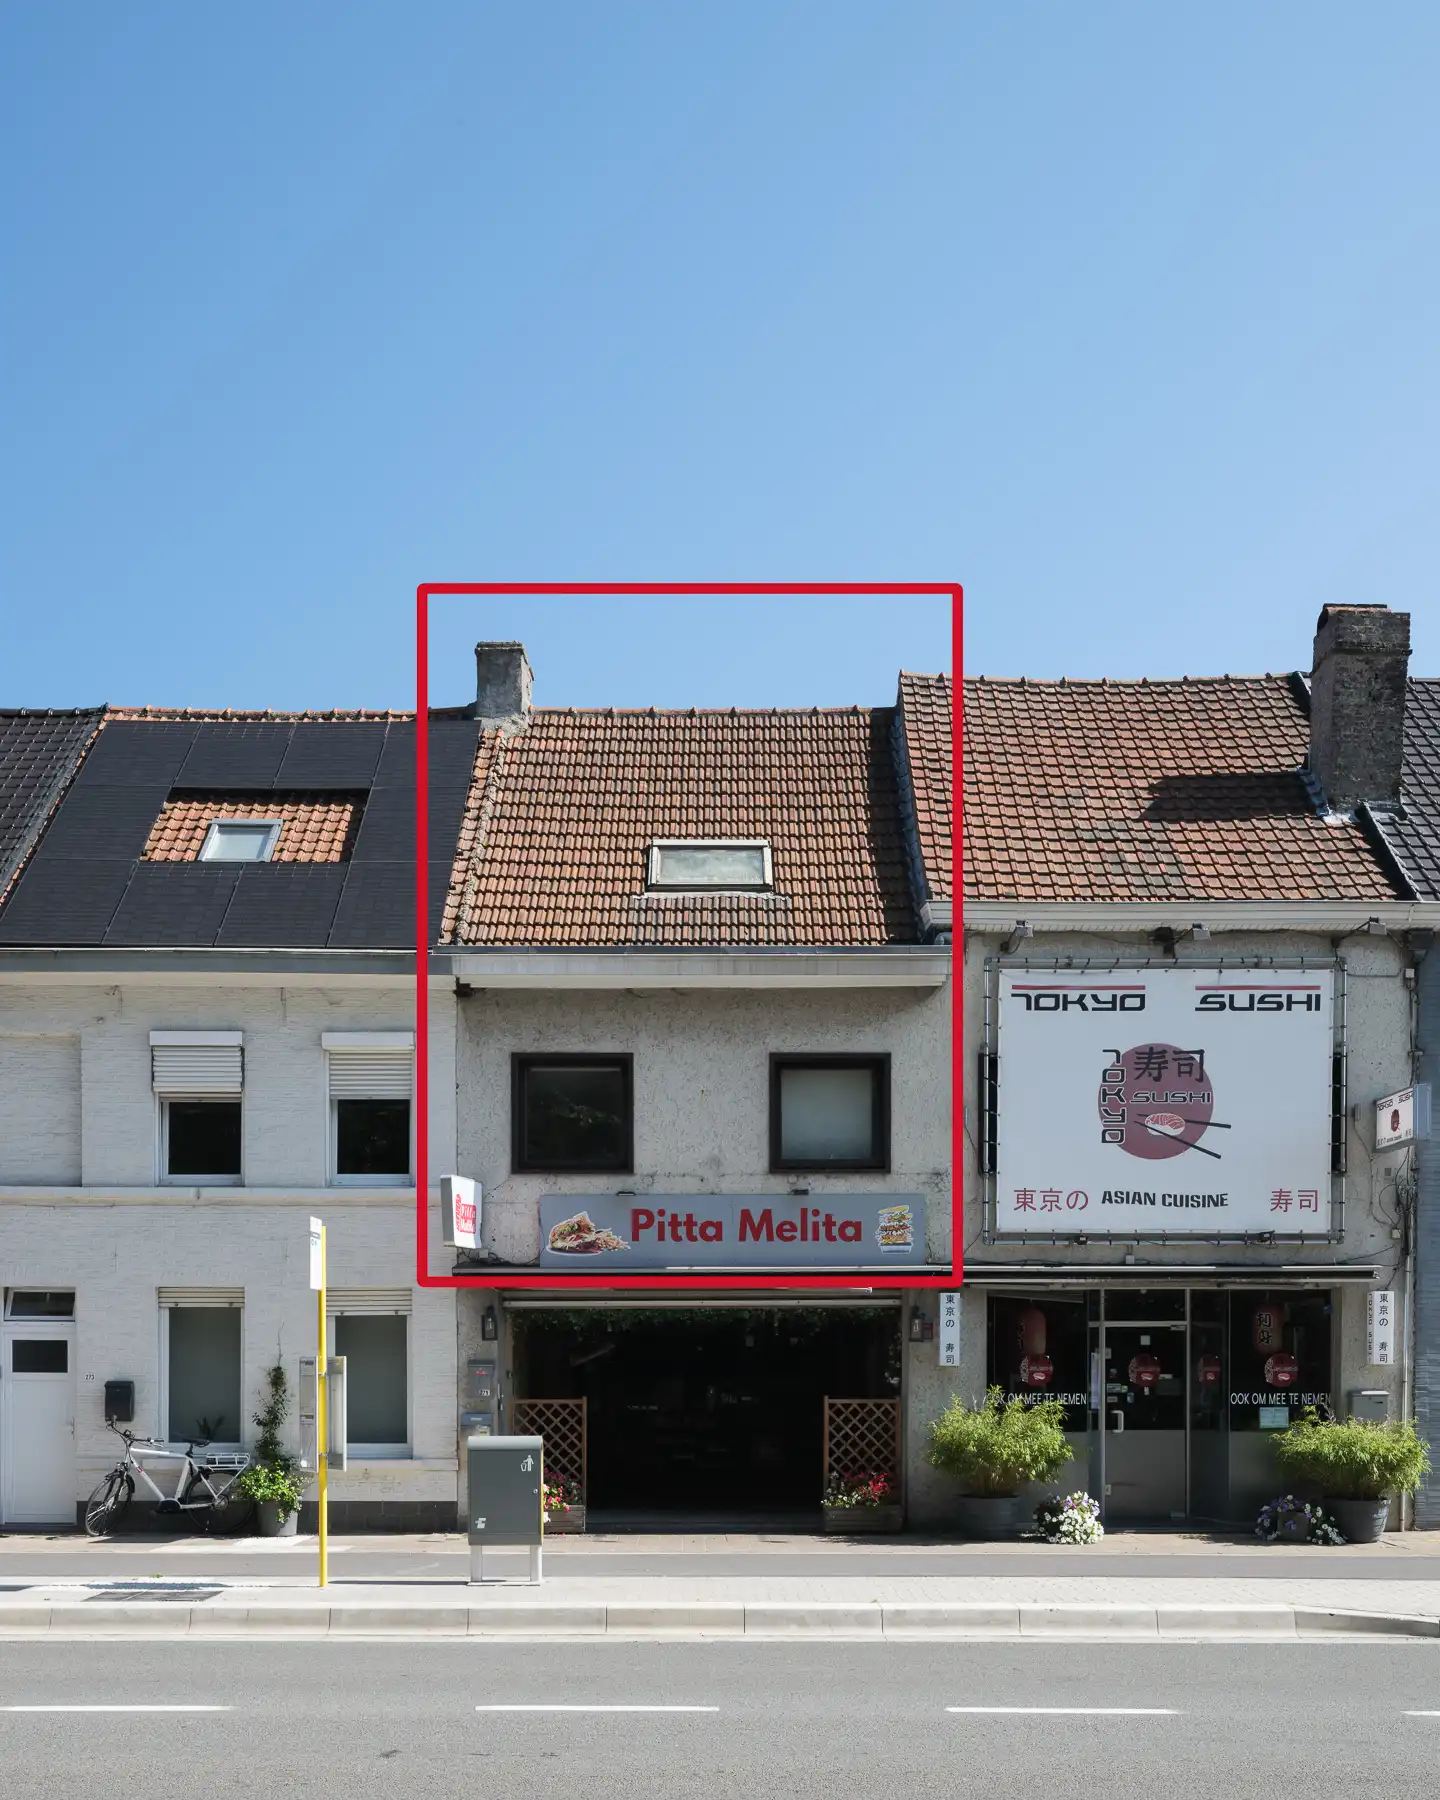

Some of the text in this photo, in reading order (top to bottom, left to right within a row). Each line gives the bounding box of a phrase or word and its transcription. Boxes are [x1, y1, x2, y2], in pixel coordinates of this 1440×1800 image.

[1011, 993, 1321, 1011] TOKYO SUSHI
[1133, 1046, 1205, 1083] 寿司
[1101, 1049, 1126, 1144] TOKYO
[1129, 1091, 1212, 1104] SUSHI
[1013, 1187, 1089, 1212] 東京の
[1101, 1190, 1229, 1208] ASIAN CUISINE
[1270, 1188, 1319, 1212] 寿司
[631, 1207, 863, 1242] Pitta Melita
[1379, 1293, 1389, 1327] 東京の
[945, 1294, 955, 1364] 東京の 寿司
[1230, 1393, 1331, 1404] OOK OM MEE TE NEMEN
